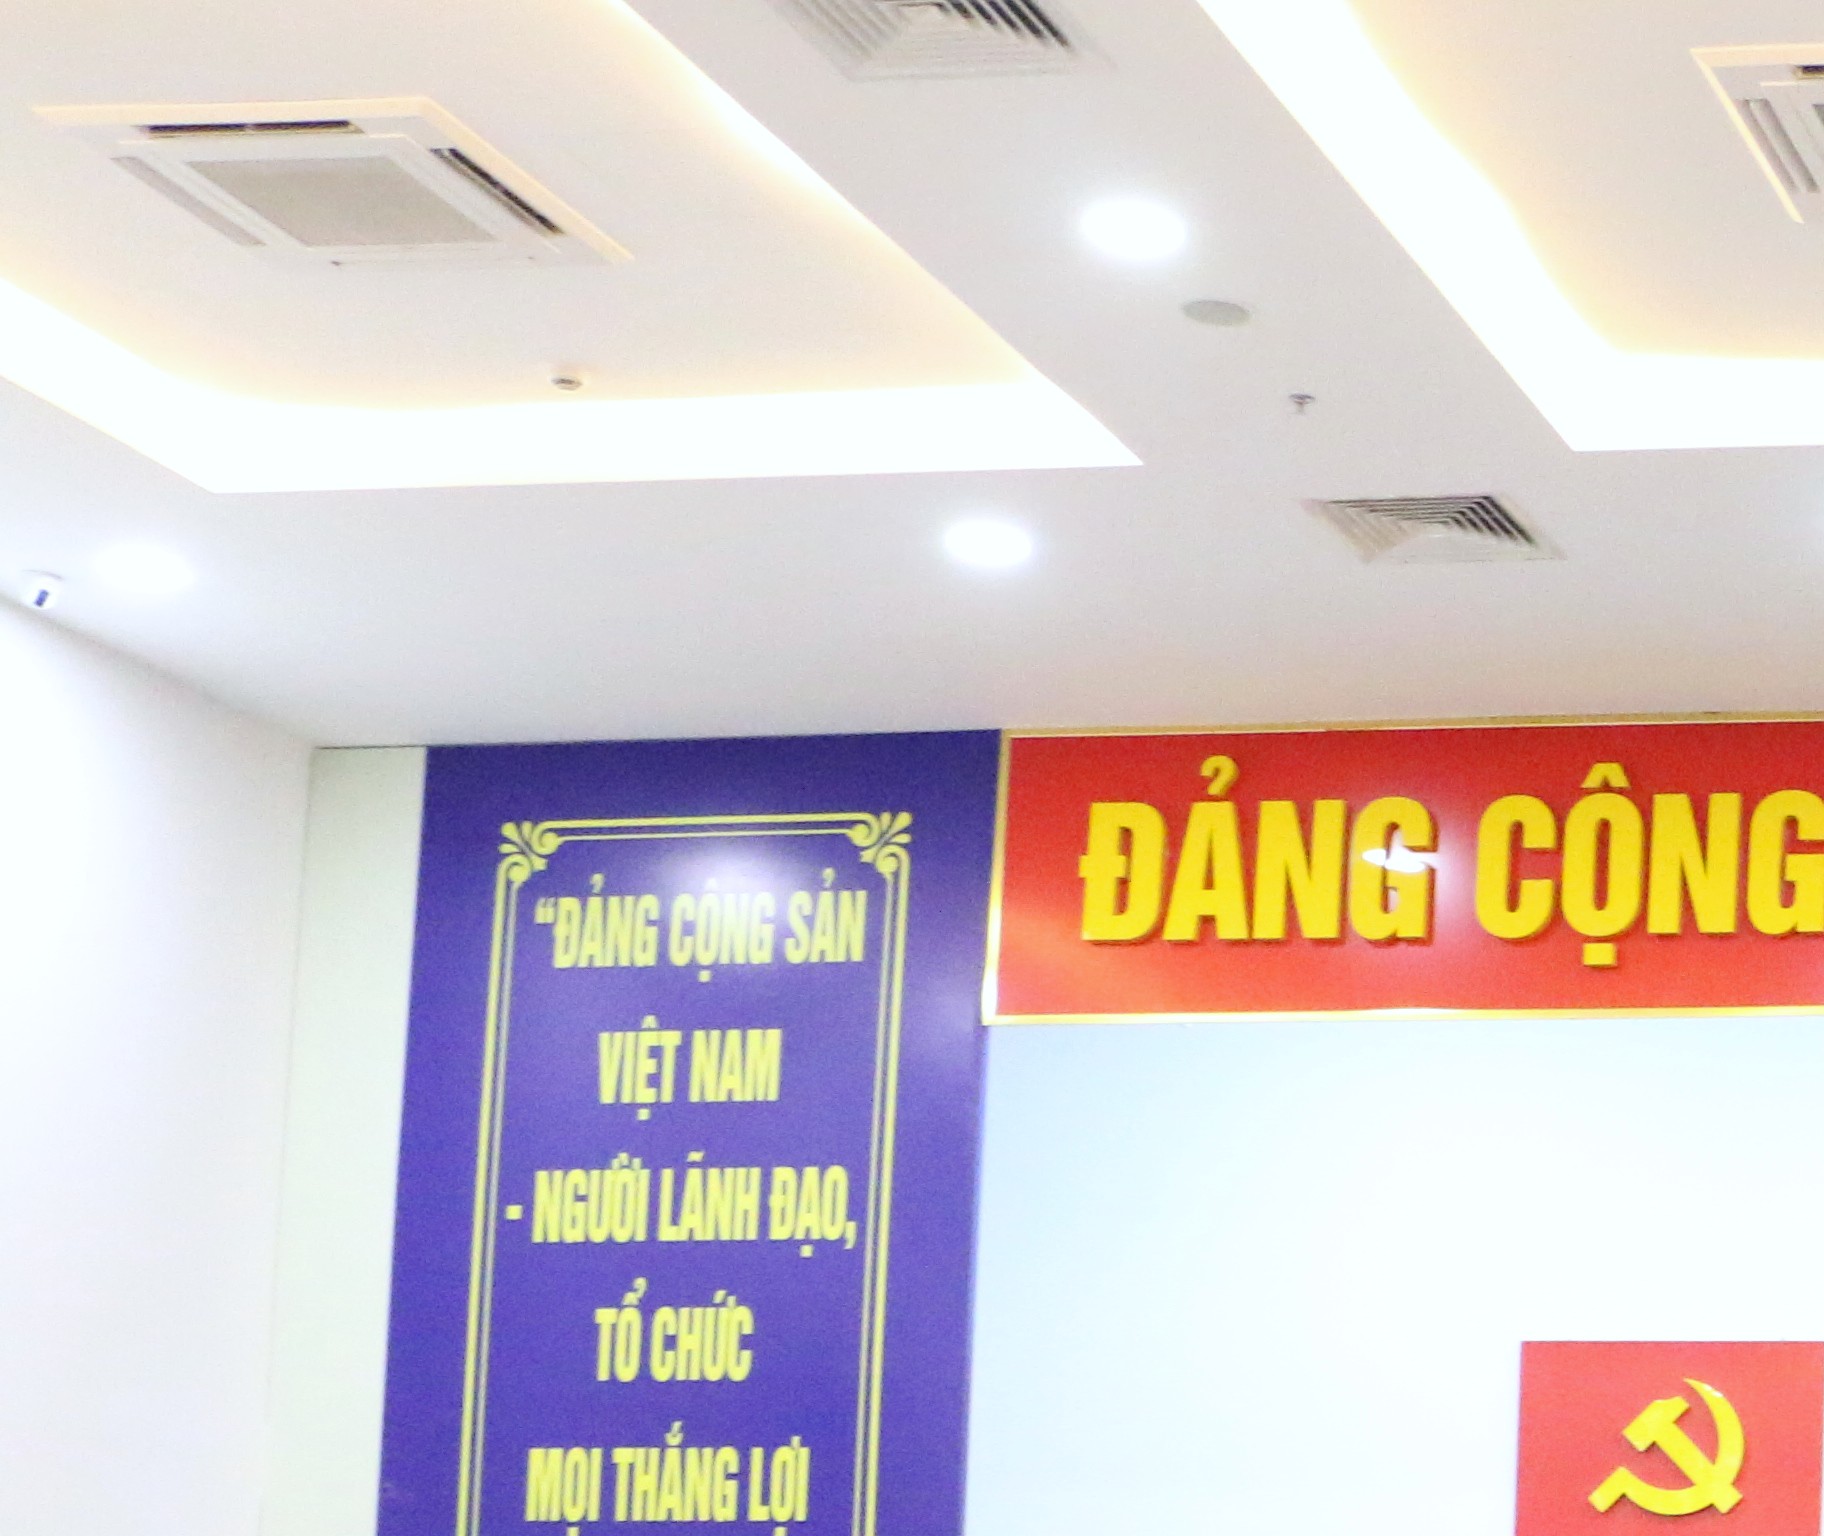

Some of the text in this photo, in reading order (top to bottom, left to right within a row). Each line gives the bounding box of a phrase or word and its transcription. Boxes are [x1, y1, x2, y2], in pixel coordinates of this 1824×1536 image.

[1078, 756, 1437, 944] ĐẢNG
[535, 869, 868, 981] “ĐẢNG CỘNG SẢN
[600, 1017, 780, 1119] VIỆT NAM
[533, 1154, 649, 1242] NGƯỜI
[658, 1152, 760, 1241] LÃNH
[769, 1166, 856, 1256] ĐẠO,
[596, 1279, 753, 1381] TỔ CHỨC
[613, 1424, 739, 1521] THẮNG
